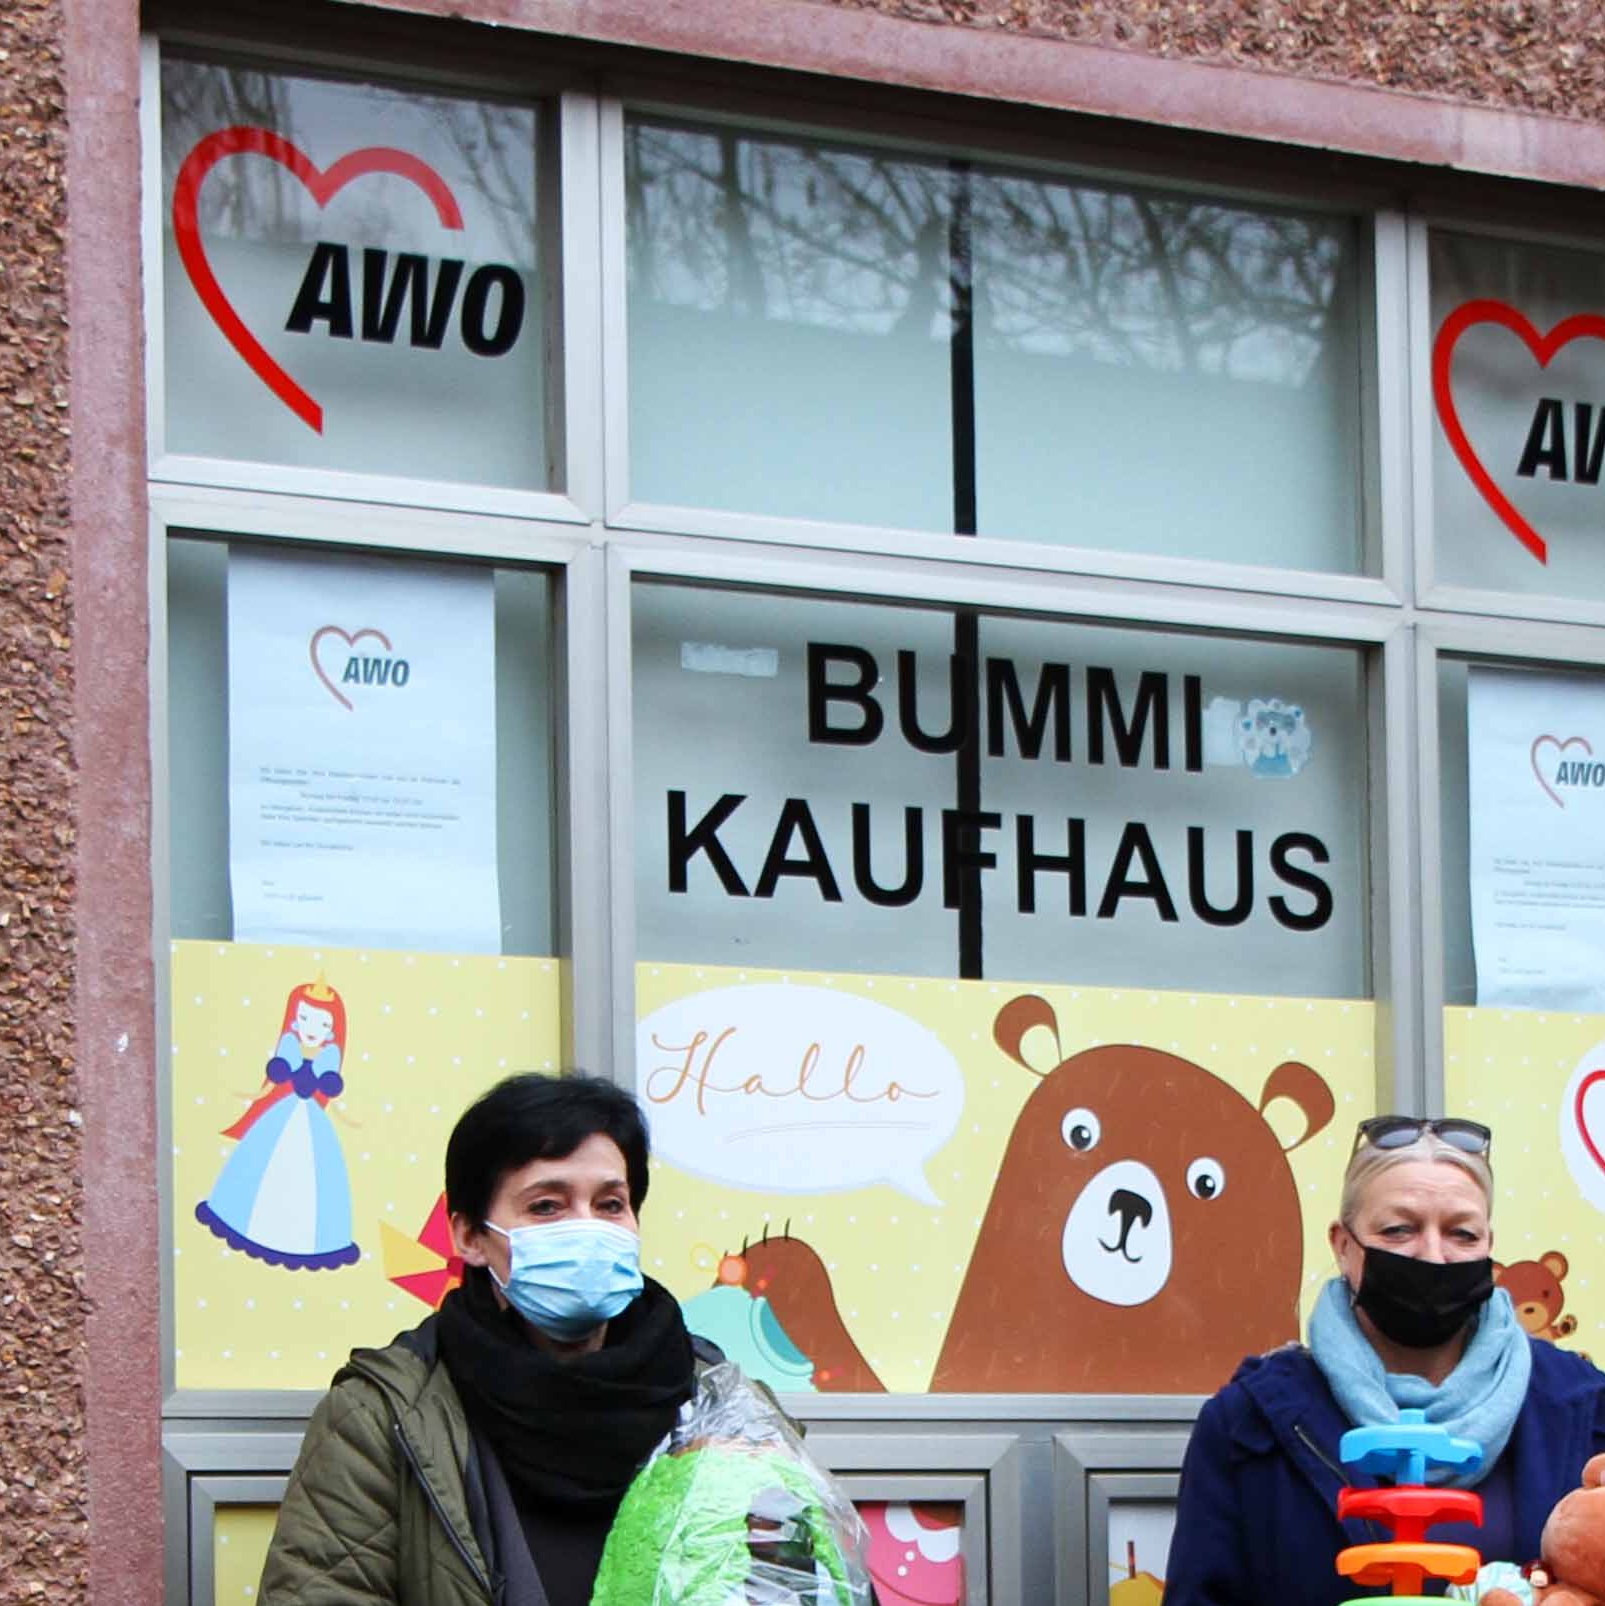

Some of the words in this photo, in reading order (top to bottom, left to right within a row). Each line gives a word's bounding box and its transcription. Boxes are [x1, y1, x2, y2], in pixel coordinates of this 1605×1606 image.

[285, 241, 526, 357] AWO
[342, 655, 411, 687] AWO
[806, 641, 1204, 773] BUMMI
[666, 789, 1334, 932] KAUFHAUS
[646, 1026, 941, 1116] Hallo
